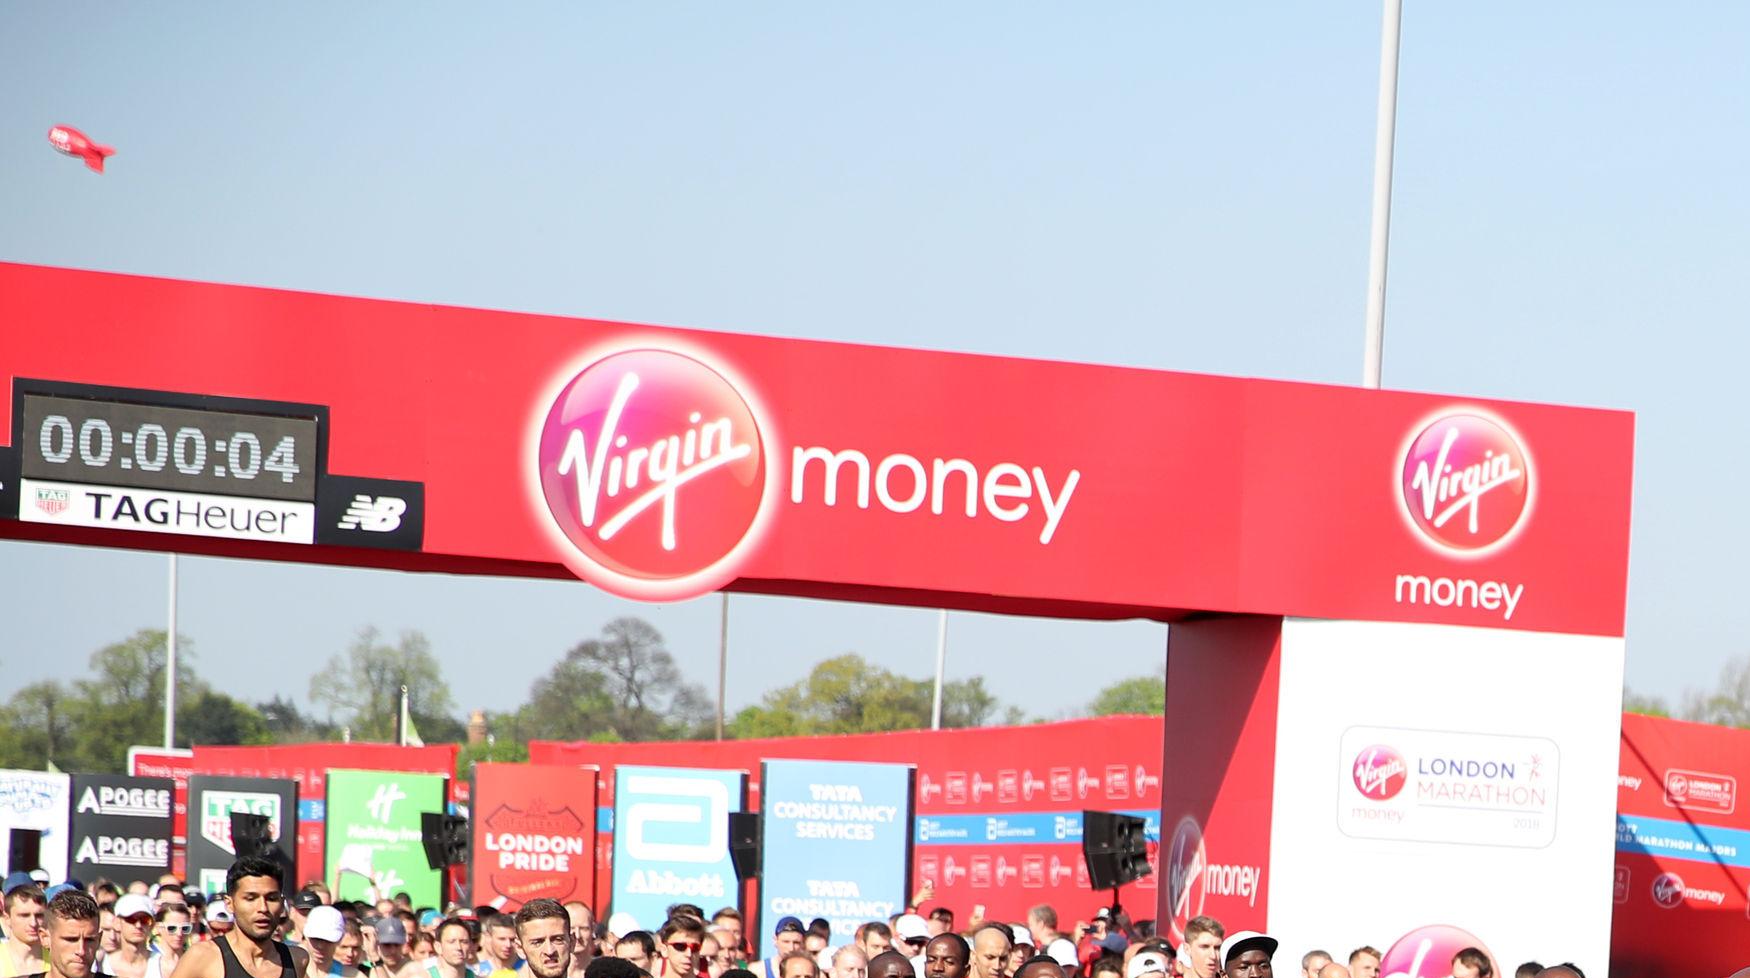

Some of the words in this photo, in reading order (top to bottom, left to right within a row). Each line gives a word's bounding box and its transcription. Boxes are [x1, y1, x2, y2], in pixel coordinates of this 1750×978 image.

[39, 414, 300, 483] 00:00:04
[558, 372, 751, 551] Virgin
[791, 446, 1080, 545] money
[1412, 427, 1520, 533] Virgin
[1395, 573, 1523, 619] money
[1355, 750, 1407, 796] Virgin
[1418, 758, 1515, 779] LONDON
[1618, 776, 1641, 790] oney
[809, 784, 863, 802] TATA
[1417, 781, 1546, 806] MARATHON
[1689, 781, 1721, 791] LONDON
[77, 786, 170, 815] APOGEE
[208, 799, 274, 817] TAG
[773, 802, 897, 823] CONSULTANCY
[1352, 807, 1405, 824] money
[796, 821, 875, 841] SERVICES
[76, 836, 168, 866] APOGEE
[485, 832, 583, 855] LONDON
[1636, 836, 1693, 851] MARATHON
[1695, 844, 1737, 856] MAJORS
[499, 851, 569, 872] PRIDE
[626, 870, 724, 897] Abbott
[807, 880, 860, 897] TATA
[1206, 863, 1260, 907] money
[771, 897, 894, 918] CONSULTANCY
[1685, 890, 1725, 905] money
